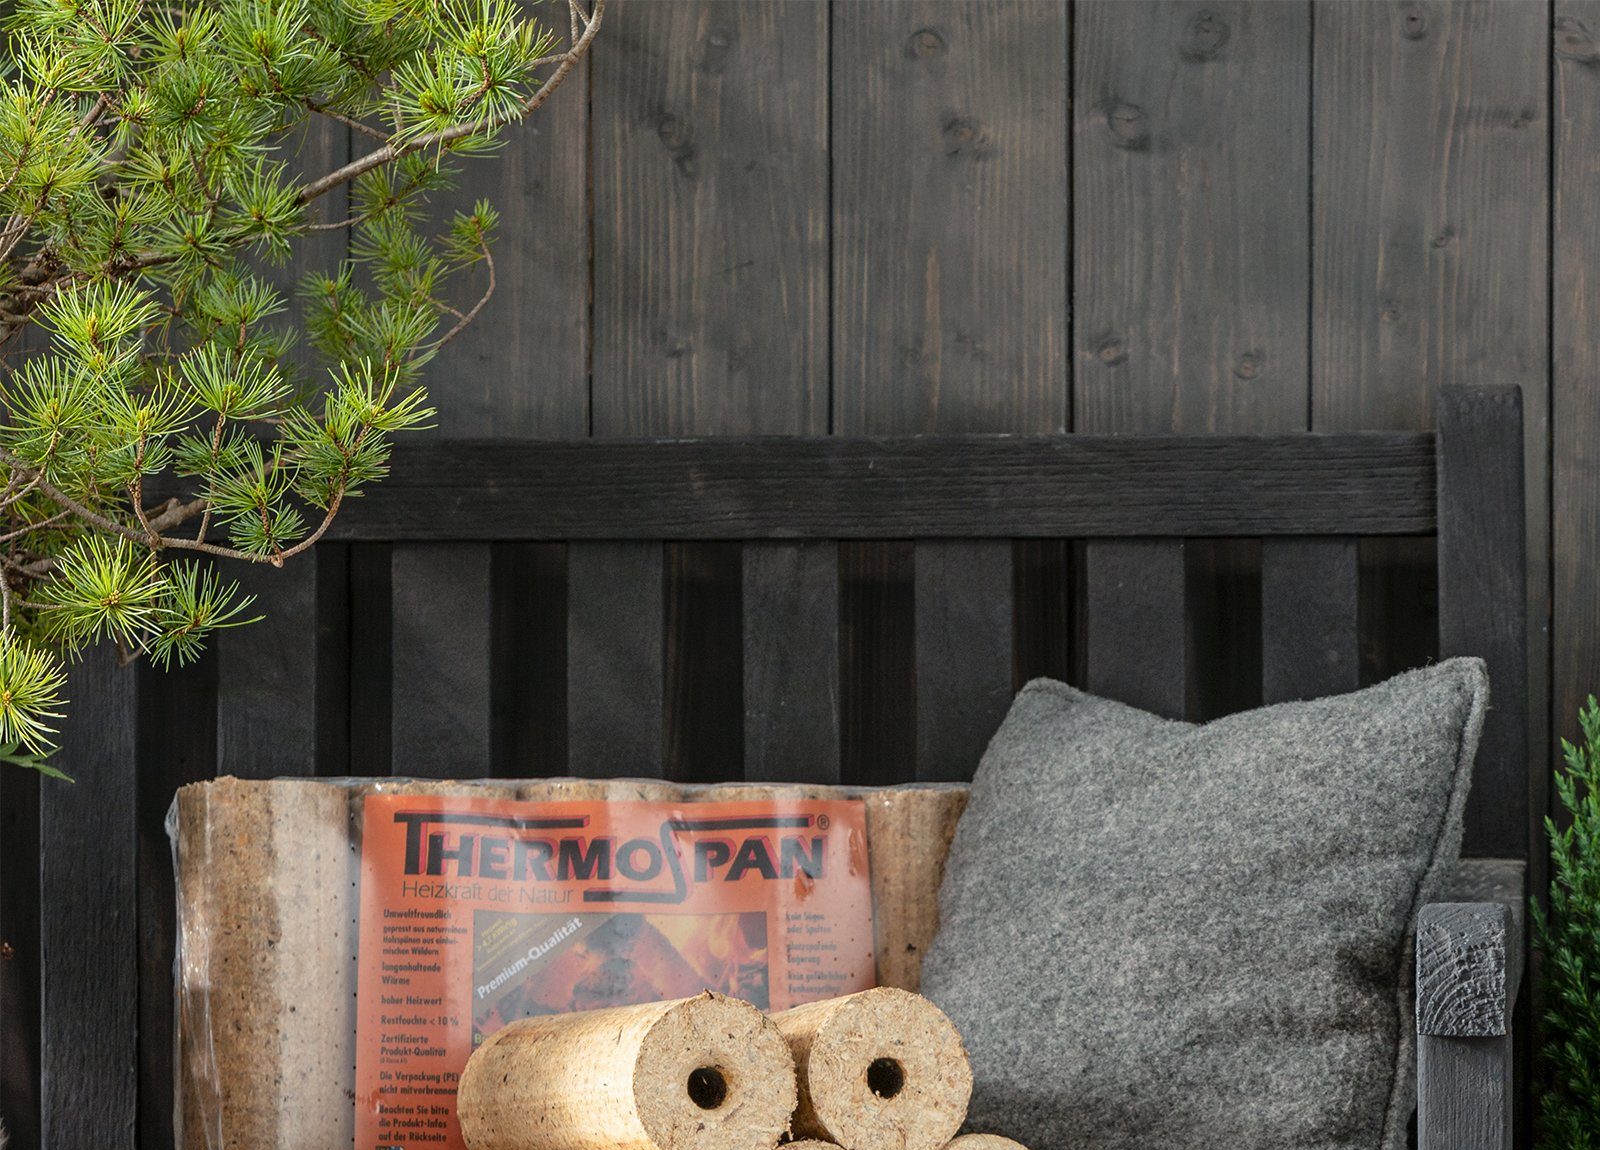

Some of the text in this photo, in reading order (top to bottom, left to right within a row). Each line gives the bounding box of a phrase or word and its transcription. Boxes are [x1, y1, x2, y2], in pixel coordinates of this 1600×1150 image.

[394, 809, 828, 904] THERMOSPAN
[402, 881, 574, 904] Heizkraft der Natur
[476, 917, 583, 999] Premium-Qualität
[406, 995, 442, 1006] Heizwert
[381, 1034, 429, 1044] Zertifizierte
[381, 1047, 446, 1057] Produkt-Qualität
[380, 1072, 392, 1080] Die
[395, 1072, 441, 1084] Verpackung
[379, 1085, 398, 1094] nicht
[379, 1104, 449, 1115] Beachten Sie bitte
[379, 1119, 447, 1128] die Produkt-Infos
[378, 1131, 447, 1142] auf der Rückseite
